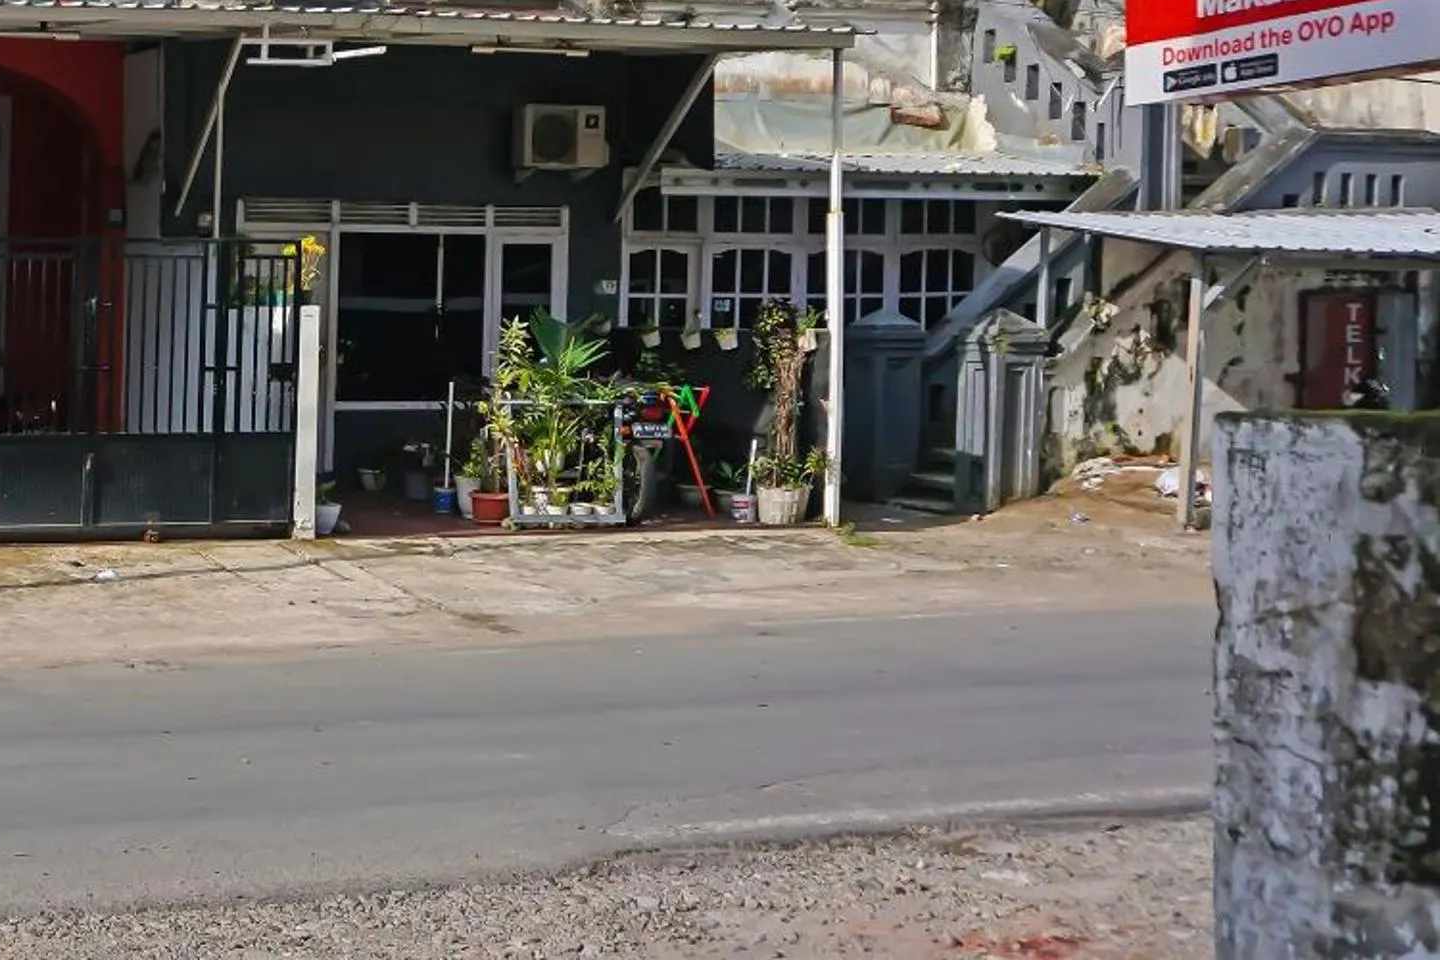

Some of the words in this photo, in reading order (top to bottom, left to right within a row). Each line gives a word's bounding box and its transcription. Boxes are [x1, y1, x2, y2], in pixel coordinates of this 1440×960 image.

[1163, 33, 1255, 66] Download
[1260, 27, 1293, 49] the
[1298, 14, 1345, 41] OYO
[1350, 11, 1395, 36] App
